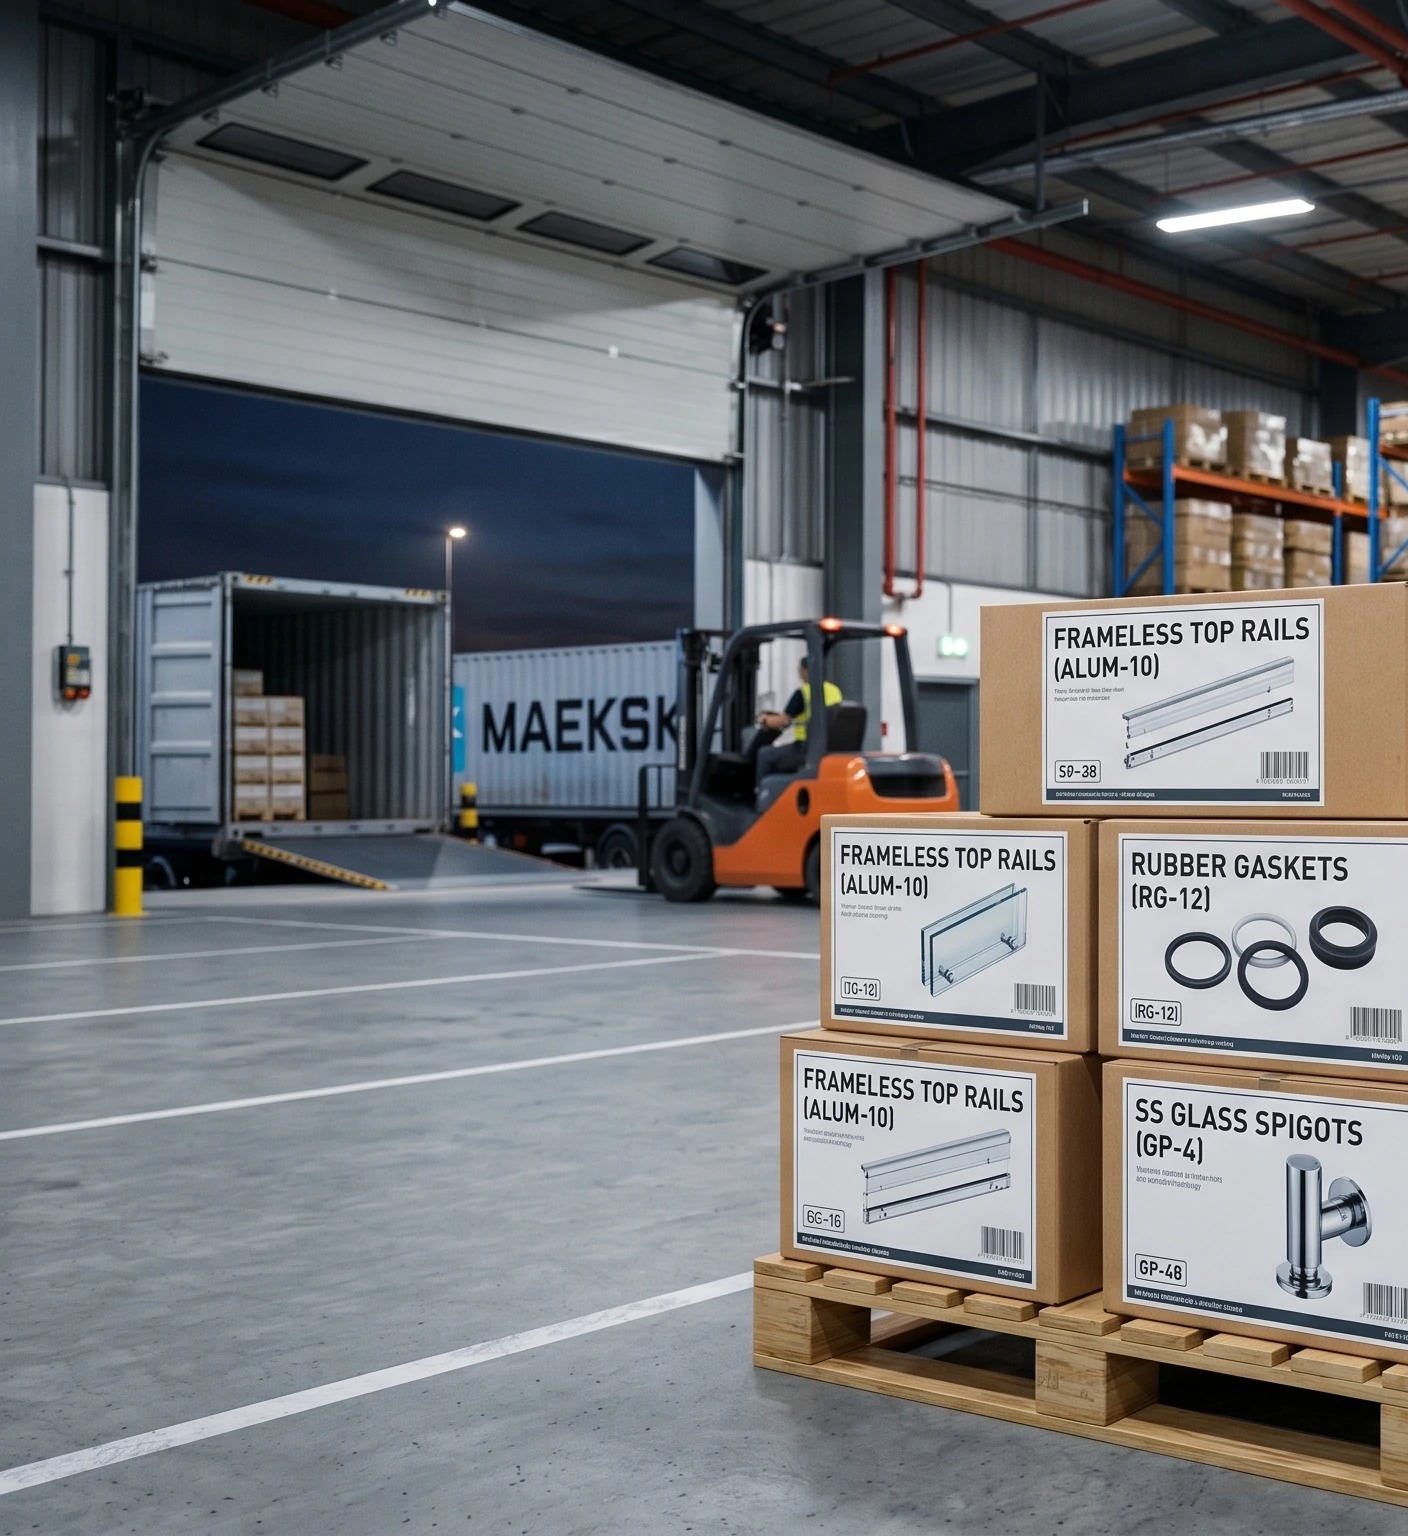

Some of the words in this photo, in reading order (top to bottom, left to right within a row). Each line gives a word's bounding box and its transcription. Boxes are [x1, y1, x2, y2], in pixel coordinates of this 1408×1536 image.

[1054, 623, 1182, 648] FRAMELESS
[1190, 620, 1233, 643] TOP
[1241, 616, 1309, 641] RAILS
[1054, 652, 1159, 682] (ALUM-10)
[840, 844, 948, 867] FRAMELESS
[954, 847, 991, 868] TOP
[998, 848, 1056, 871] RAILS
[1131, 852, 1226, 878] RUBBER
[1234, 854, 1348, 881] GASKETS
[840, 872, 928, 899] (ALUM-10)
[1131, 883, 1210, 912] (RG-12)
[1134, 1002, 1177, 1021] (RG-12)
[804, 1067, 914, 1100] FRAMELESS
[920, 1080, 958, 1104] TOP
[965, 1085, 1023, 1112] RAILS
[803, 1096, 894, 1131] (ALUM-10)
[1135, 1098, 1164, 1124] SS
[1170, 1101, 1247, 1132] GLASS
[1254, 1110, 1362, 1145] SPIGOTS
[1136, 1129, 1203, 1165] (GP-4)
[1139, 1259, 1182, 1280] GP-48
